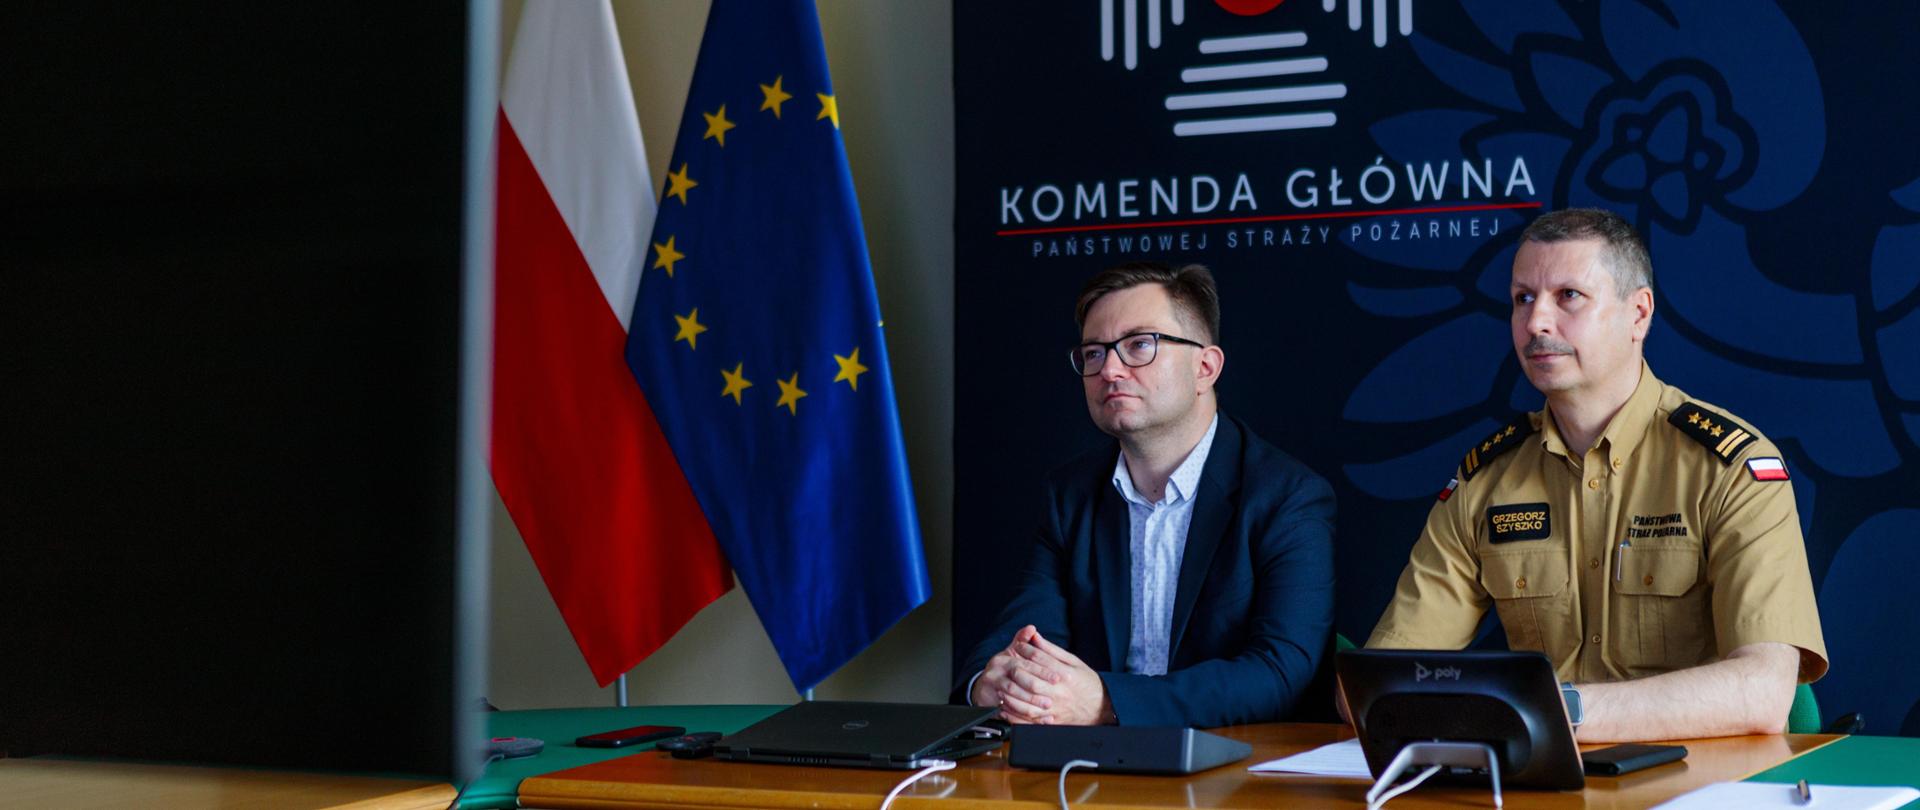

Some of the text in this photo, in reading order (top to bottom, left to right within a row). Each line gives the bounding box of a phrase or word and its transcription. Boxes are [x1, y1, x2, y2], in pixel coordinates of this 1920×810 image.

[1001, 157, 1536, 225] KOMENDA GŁÓWNA
[1033, 218, 1499, 257] PAŃSTWOWEJ STRAŻY POŻARNEJ
[1492, 511, 1546, 524] GRZEGORZ
[1496, 520, 1542, 533] SZYSZKO
[1434, 665, 1461, 680] poly
